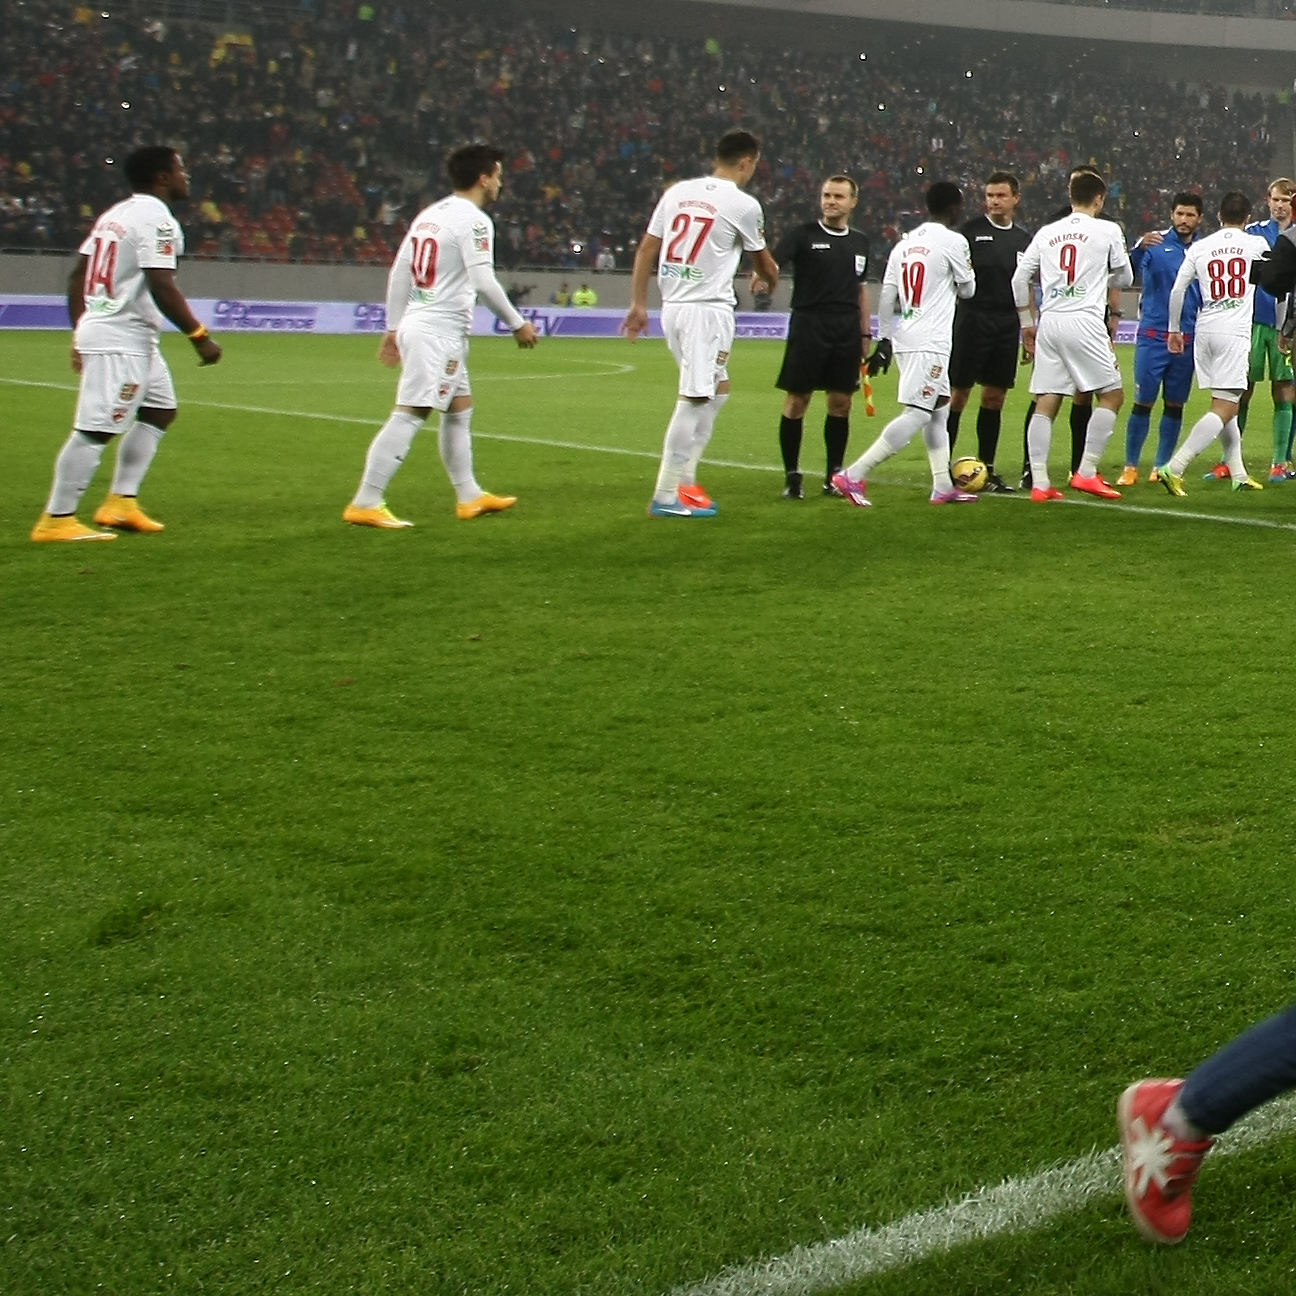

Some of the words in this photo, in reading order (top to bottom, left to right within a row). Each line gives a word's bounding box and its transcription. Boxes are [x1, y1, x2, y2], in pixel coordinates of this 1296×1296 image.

[410, 237, 438, 288] 10
[666, 213, 715, 265] 27
[87, 237, 118, 299] 14
[901, 261, 925, 308] 19
[1060, 244, 1077, 286] 9
[1207, 257, 1246, 301] 88
